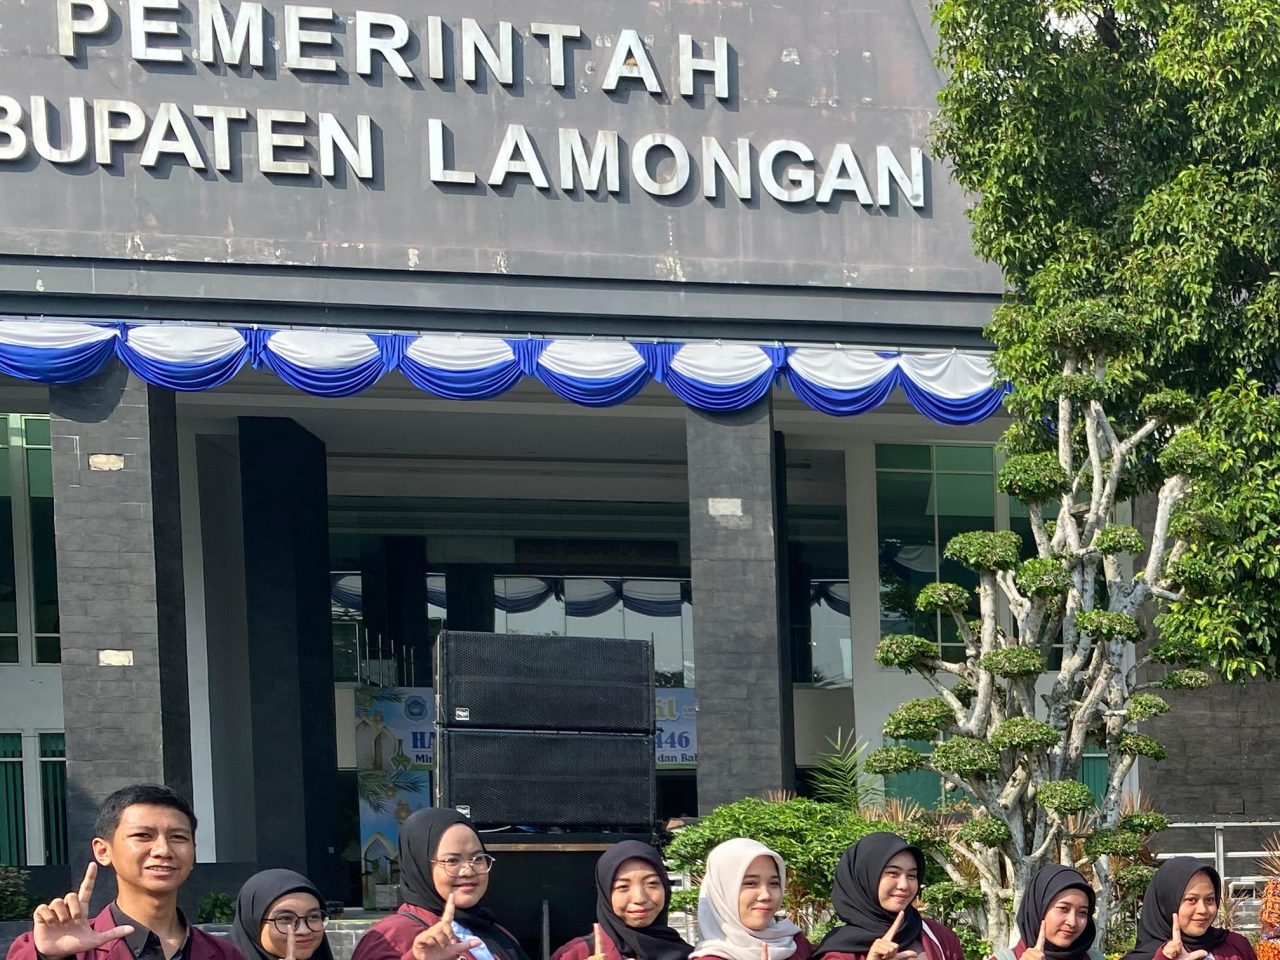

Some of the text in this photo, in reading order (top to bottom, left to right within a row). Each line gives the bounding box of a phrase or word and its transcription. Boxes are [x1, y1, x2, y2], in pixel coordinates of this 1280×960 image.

[57, 0, 728, 98] PEMERINTAH
[428, 118, 925, 208] LAMONGAN
[655, 731, 690, 748] 446
[657, 753, 678, 762] dan
